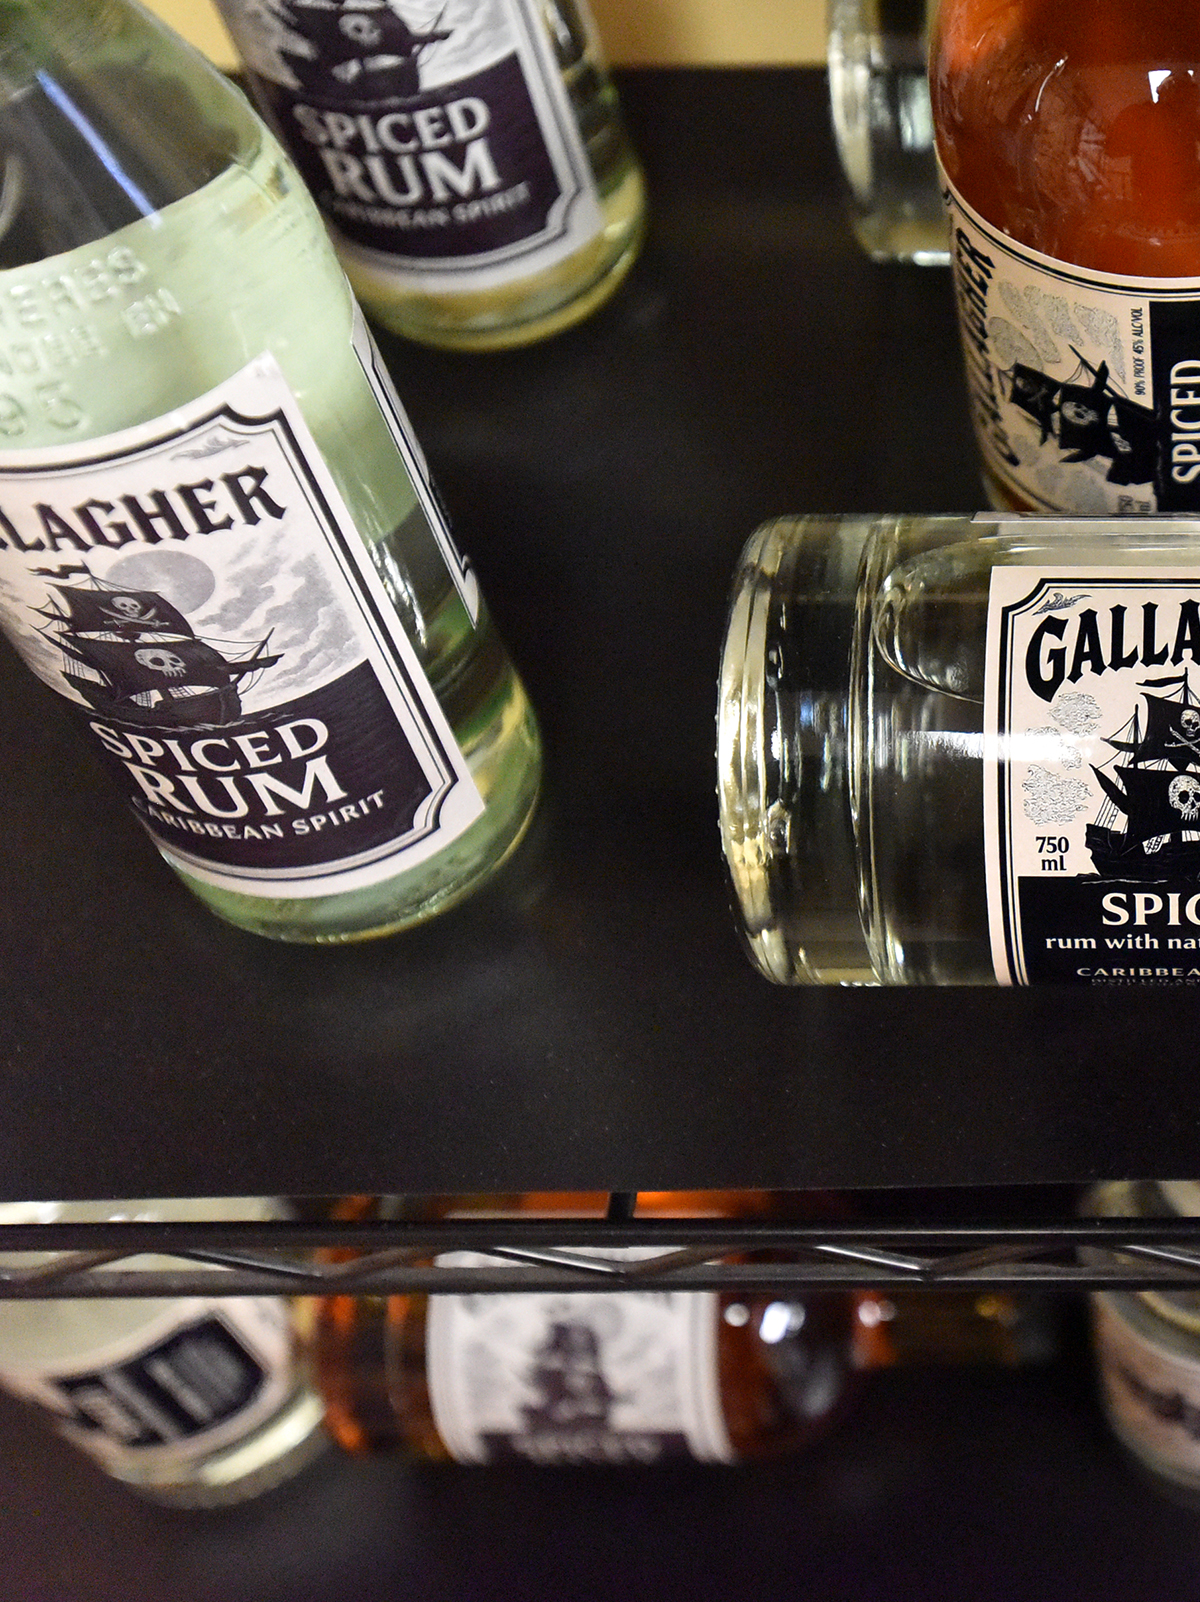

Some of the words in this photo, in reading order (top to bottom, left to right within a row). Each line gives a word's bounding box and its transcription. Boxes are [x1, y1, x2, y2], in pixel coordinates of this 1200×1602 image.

[293, 96, 492, 153] SPICED
[320, 138, 501, 207] RUM
[0, 464, 287, 553] LAGHER
[89, 717, 329, 773] SPICED
[121, 754, 348, 819] RUM
[291, 789, 385, 836] SPIRIT
[1035, 836, 1070, 853] 750
[1045, 936, 1097, 950] rum
[1104, 933, 1160, 950] with
